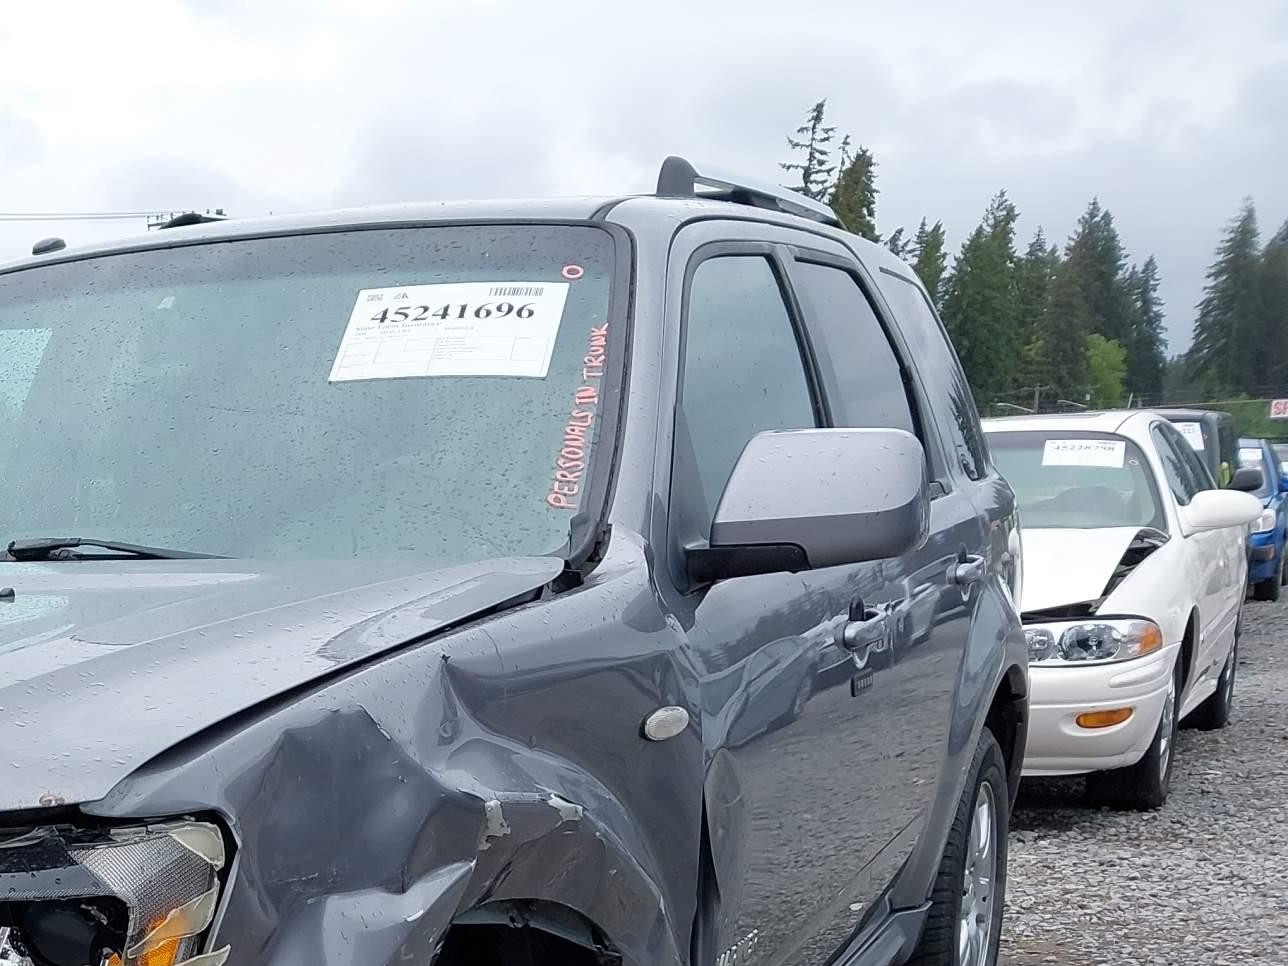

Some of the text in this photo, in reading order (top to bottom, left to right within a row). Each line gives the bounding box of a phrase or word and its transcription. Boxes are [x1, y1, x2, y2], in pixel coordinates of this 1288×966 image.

[370, 301, 536, 323] 45241696
[546, 322, 609, 508] PERSONALS IN TRUNK
